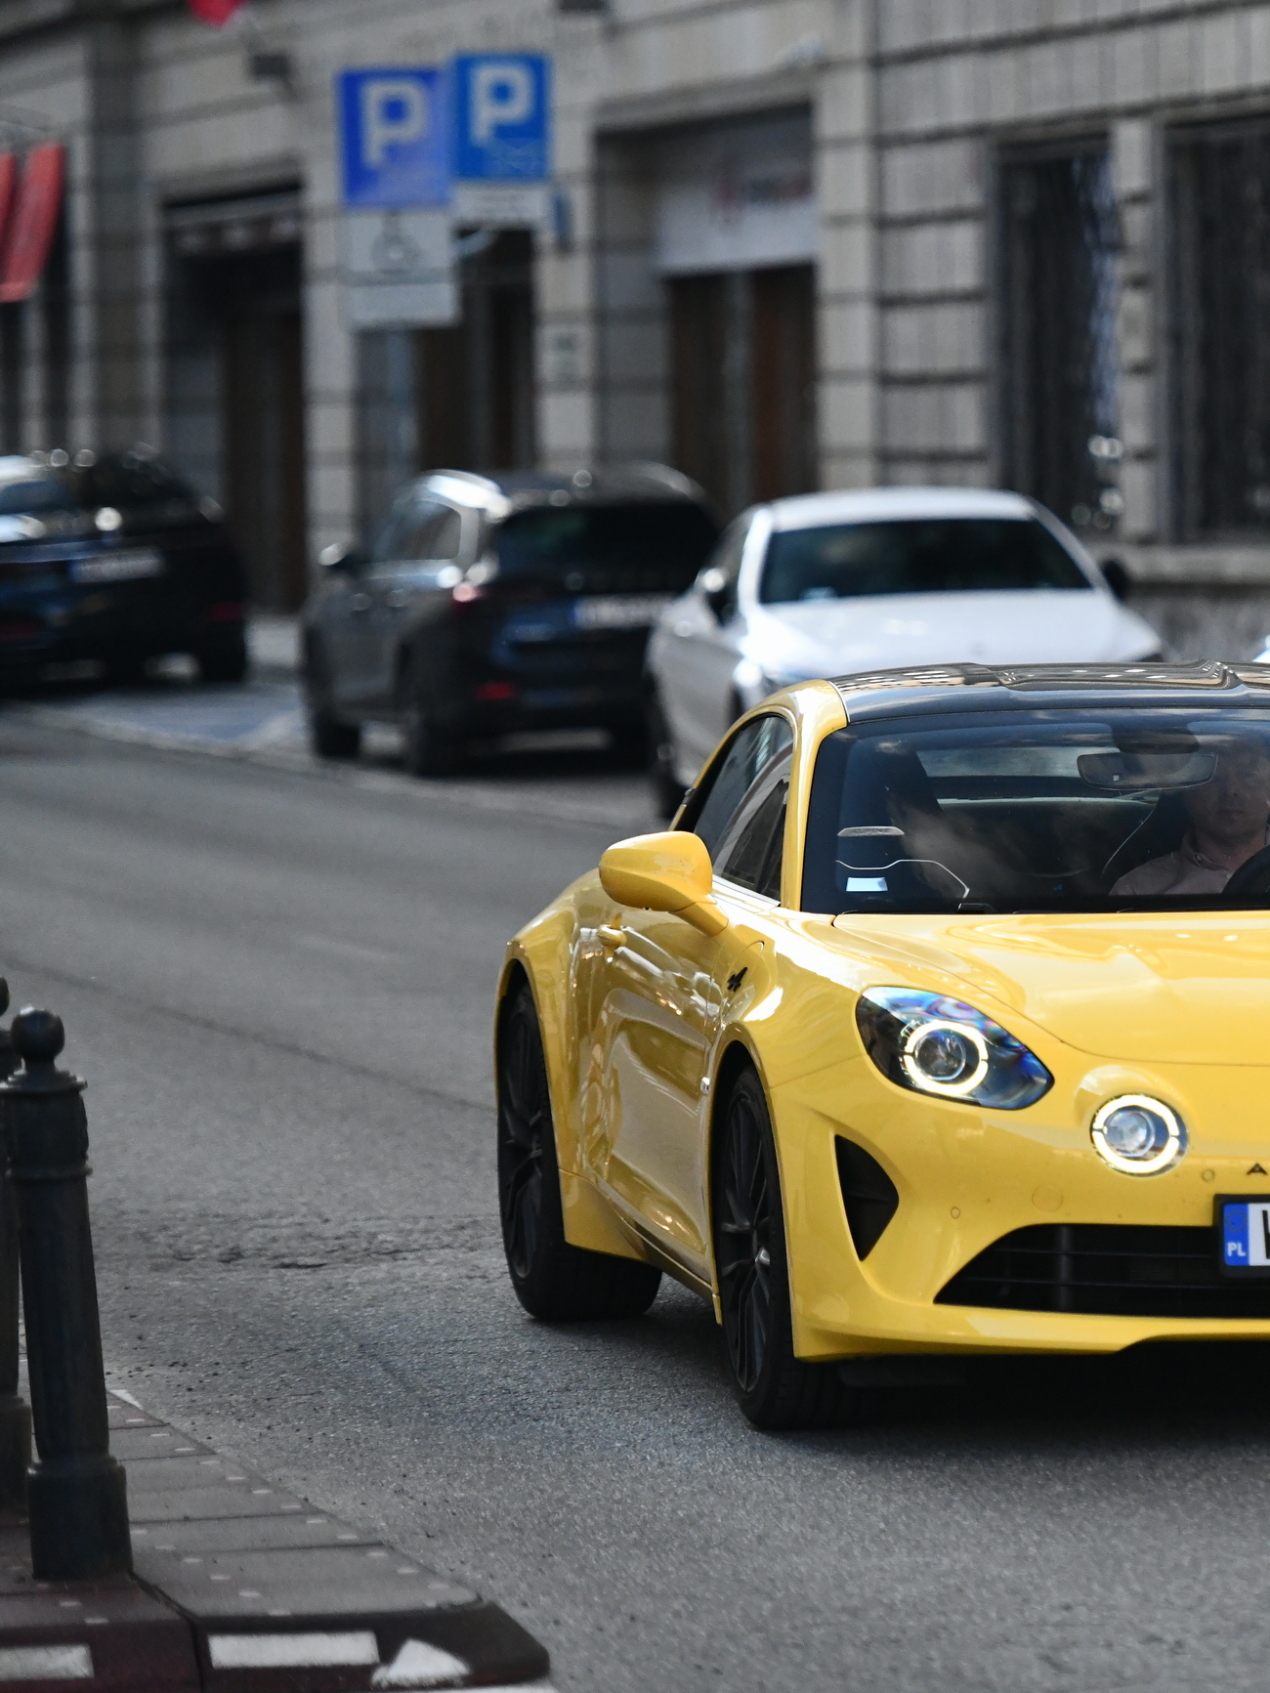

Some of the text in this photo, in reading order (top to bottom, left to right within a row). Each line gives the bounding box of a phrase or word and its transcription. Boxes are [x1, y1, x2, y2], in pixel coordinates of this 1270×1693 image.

[361, 79, 427, 168] P
[469, 62, 534, 144] P
[1227, 1241, 1247, 1257] PL
